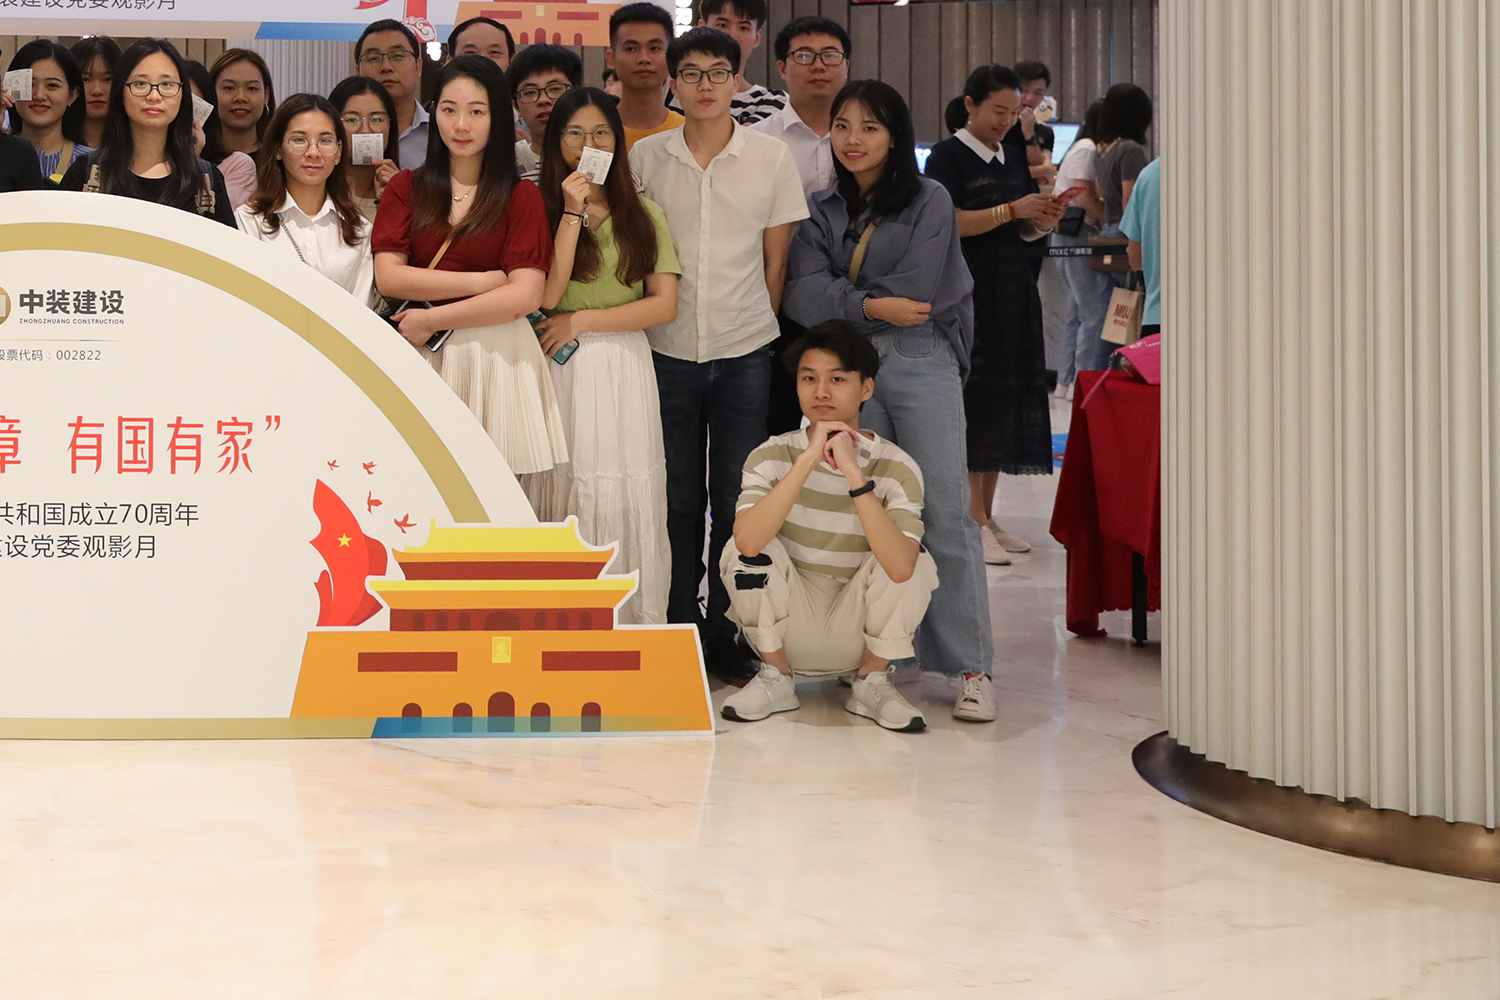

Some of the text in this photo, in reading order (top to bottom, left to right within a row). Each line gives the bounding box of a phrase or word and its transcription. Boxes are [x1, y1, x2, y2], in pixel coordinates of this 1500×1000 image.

[17, 287, 126, 316] 中装建设
[18, 317, 126, 325] ZHONGZHUANG CONSTRUCTION
[66, 414, 281, 476] 有国有家”
